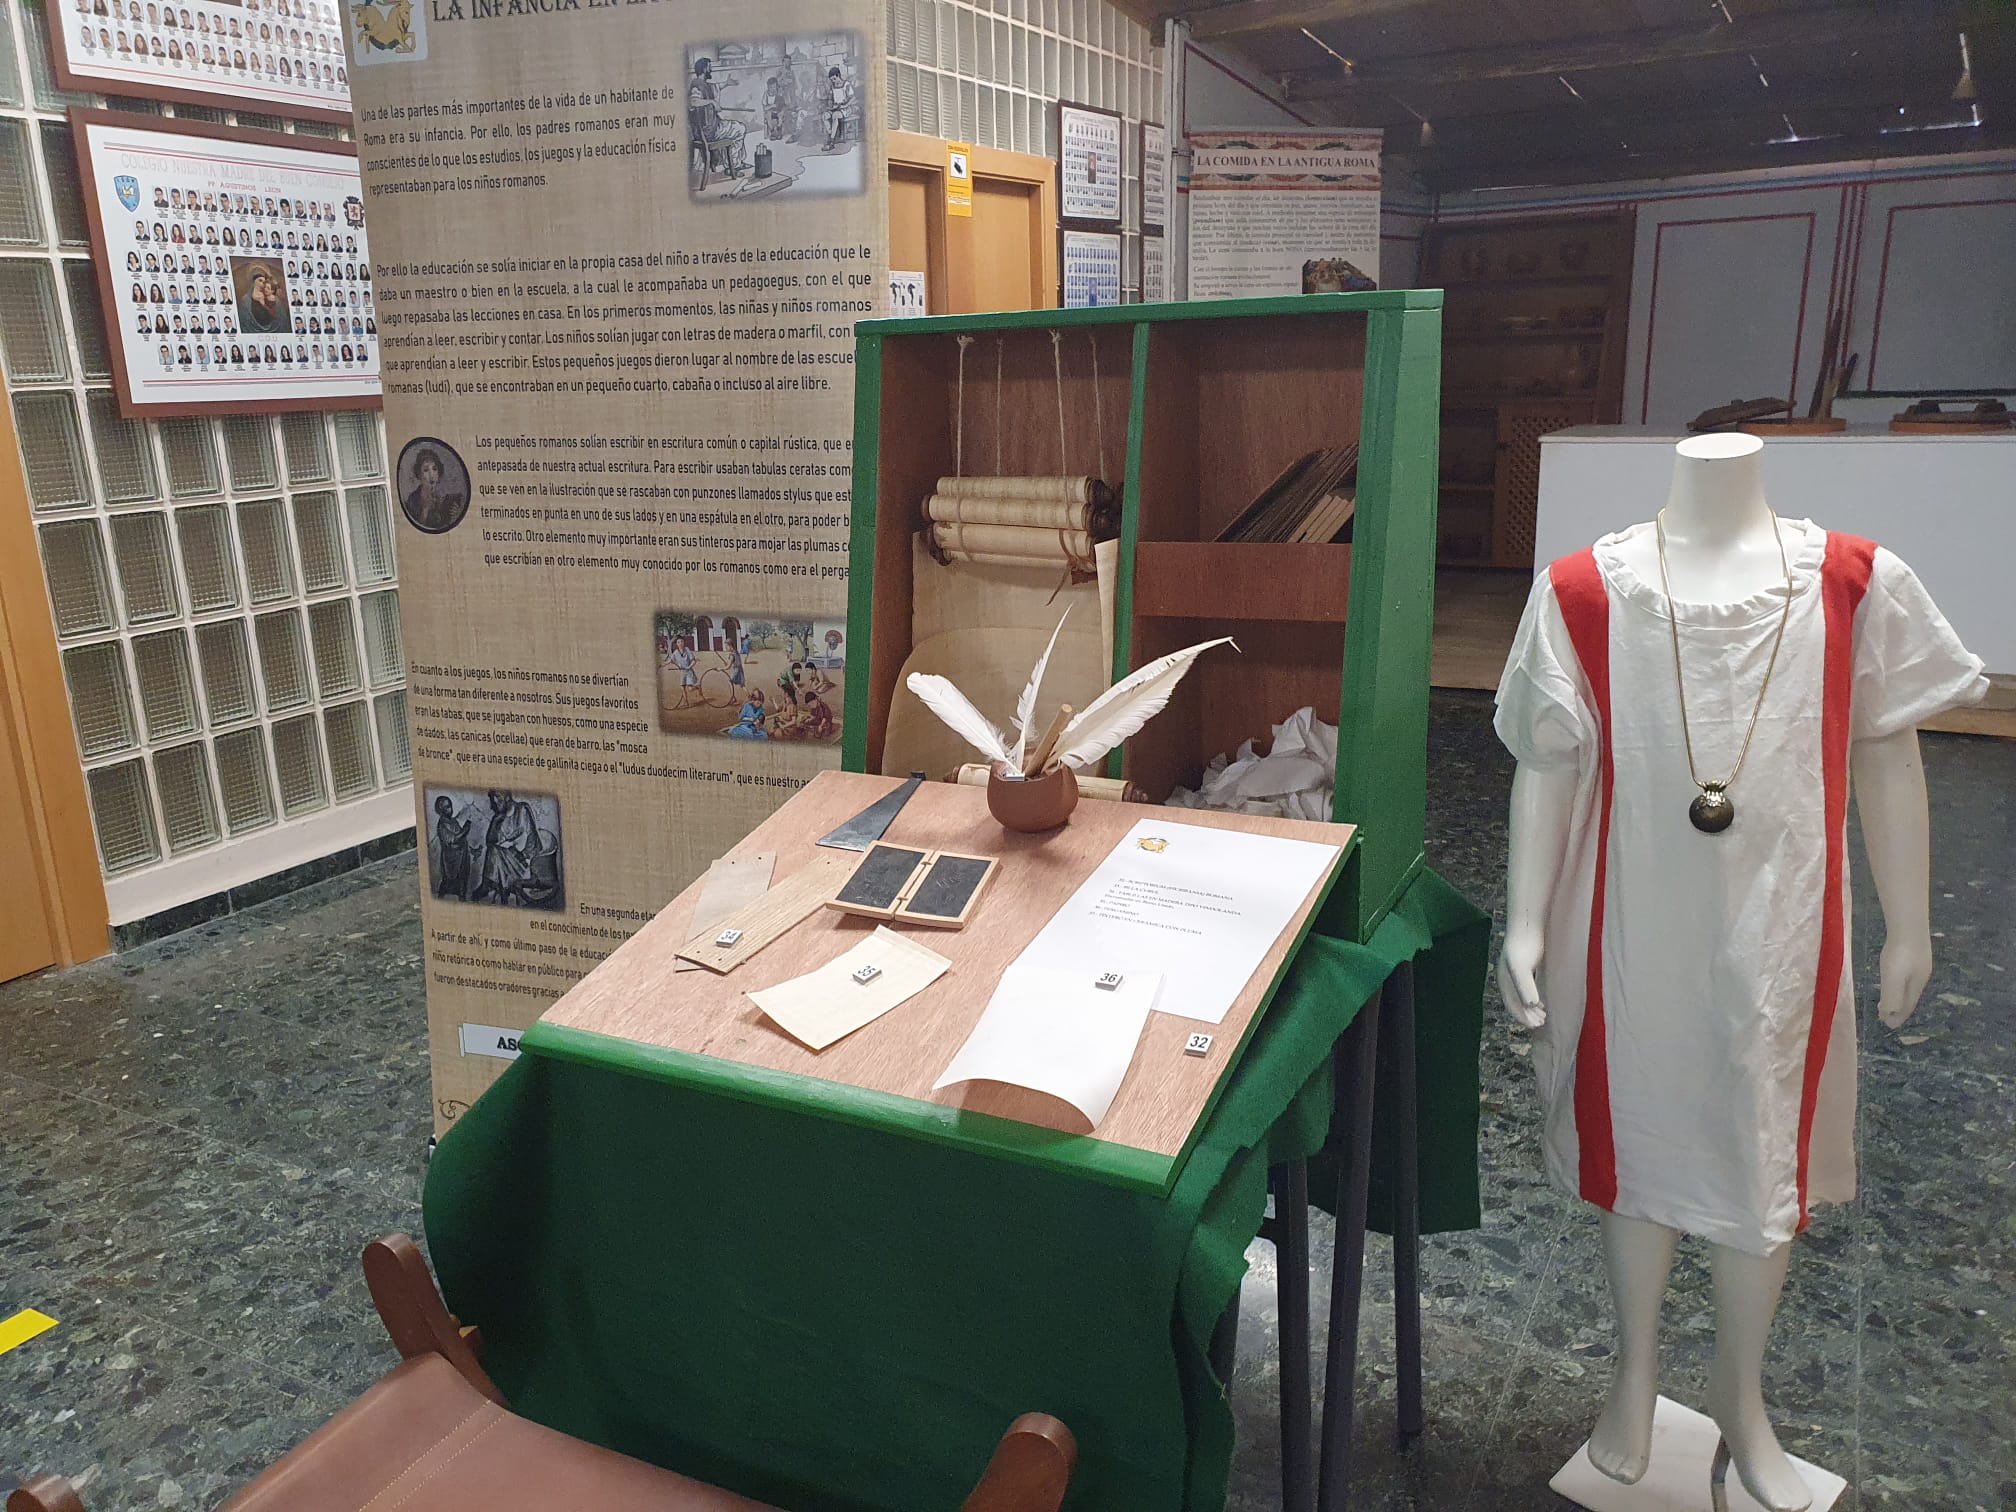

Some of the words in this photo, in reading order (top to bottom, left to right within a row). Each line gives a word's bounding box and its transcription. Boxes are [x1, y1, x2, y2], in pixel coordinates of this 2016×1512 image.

[433, 0, 465, 21] LA
[361, 110, 376, 121] Una
[377, 107, 388, 119] de
[390, 105, 405, 118] las
[407, 104, 439, 120] partes
[441, 99, 463, 115] más
[465, 99, 525, 115] importantes
[528, 95, 540, 109] de
[542, 95, 552, 108] la
[554, 92, 575, 107] vida
[578, 92, 590, 105] de
[594, 93, 607, 104] un
[609, 88, 658, 103] habitante
[661, 86, 673, 99] de
[364, 133, 385, 145] Roma
[389, 133, 404, 143] era
[408, 132, 420, 142] su
[424, 126, 466, 141] infancia.
[470, 125, 487, 138] Por
[516, 122, 531, 136] los
[535, 120, 570, 137] padres
[574, 118, 620, 131] romanos
[624, 116, 648, 128] eran
[653, 115, 675, 128] muy
[366, 155, 416, 171] conscientes
[417, 153, 429, 167] de
[430, 152, 440, 166] lo
[442, 154, 460, 168] que
[462, 151, 477, 164] los
[524, 147, 539, 161] los
[541, 146, 574, 162] juegos
[575, 147, 581, 160] y
[583, 143, 592, 157] la
[594, 139, 646, 156] educación
[648, 137, 675, 152] física
[1197, 156, 1210, 166] LA
[1213, 156, 1258, 167] COMIDA
[1261, 156, 1275, 167] EN
[1278, 156, 1292, 167] LA
[1294, 157, 1342, 167] ANTIGUA
[1344, 158, 1376, 168] ROMA
[369, 179, 432, 195] representaban
[431, 180, 455, 193] para
[456, 176, 472, 190] los
[474, 174, 500, 188] niños
[502, 175, 548, 187] romanos.
[379, 288, 396, 300] daba
[399, 289, 411, 299] un
[414, 286, 457, 298] maestro
[461, 287, 467, 297] o
[471, 284, 493, 297] bien
[497, 286, 509, 296] en
[513, 283, 523, 296] la
[573, 283, 579, 294] a
[583, 280, 592, 293] la
[596, 279, 619, 293] cual
[623, 279, 633, 292] le
[637, 276, 707, 293] acompañaba
[711, 278, 725, 289] un
[805, 274, 826, 286] con
[831, 271, 843, 285] el
[847, 274, 871, 288] que
[381, 312, 401, 326] luego
[403, 309, 449, 324] repasaba
[452, 309, 468, 321] las
[470, 308, 519, 321] lecciones
[522, 310, 535, 320] en
[537, 309, 564, 319] casa.
[567, 305, 580, 318] En
[583, 304, 599, 318] los
[602, 304, 651, 320] primeros
[719, 301, 735, 314] las
[738, 300, 769, 314] niñas
[771, 302, 778, 317] y
[781, 299, 812, 312] niños
[815, 300, 871, 311] romanos
[475, 435, 491, 447] Los
[494, 434, 536, 450] pequeños
[538, 438, 577, 447] romanos
[579, 434, 607, 448] solían
[609, 435, 644, 448] escribir
[647, 438, 658, 448] en
[661, 436, 703, 448] escritura
[706, 435, 737, 449] común
[740, 439, 746, 449] o
[749, 436, 780, 452] capital
[823, 439, 841, 453] que
[845, 440, 853, 450] e
[477, 459, 527, 473] antepasada
[529, 459, 540, 471] de
[542, 460, 575, 472] nuestra
[578, 459, 605, 472] actual
[608, 460, 651, 472] escritura.
[653, 459, 675, 473] Para
[677, 460, 713, 473] escribir
[715, 460, 749, 474] usaban
[751, 461, 786, 475] tabulas
[789, 463, 826, 475] ceratas
[829, 465, 852, 475] com
[411, 661, 418, 673] En
[419, 665, 442, 675] cuanto
[443, 667, 448, 676] a
[449, 665, 462, 677] los
[493, 667, 506, 679] los
[507, 667, 530, 680] niños
[531, 672, 567, 683] romanos
[568, 674, 579, 683] no
[580, 674, 590, 684] se
[591, 673, 628, 686] divertían
[415, 706, 428, 716] eran
[428, 705, 440, 717] las
[465, 711, 480, 722] que
[481, 711, 491, 721] se
[492, 710, 525, 725] jugaban
[526, 714, 541, 724] con
[574, 718, 597, 728] como
[598, 720, 614, 730] una
[615, 720, 648, 733] especie
[858, 965, 876, 977] 35
[1100, 973, 1117, 983] 36
[1190, 1036, 1209, 1049] 32
